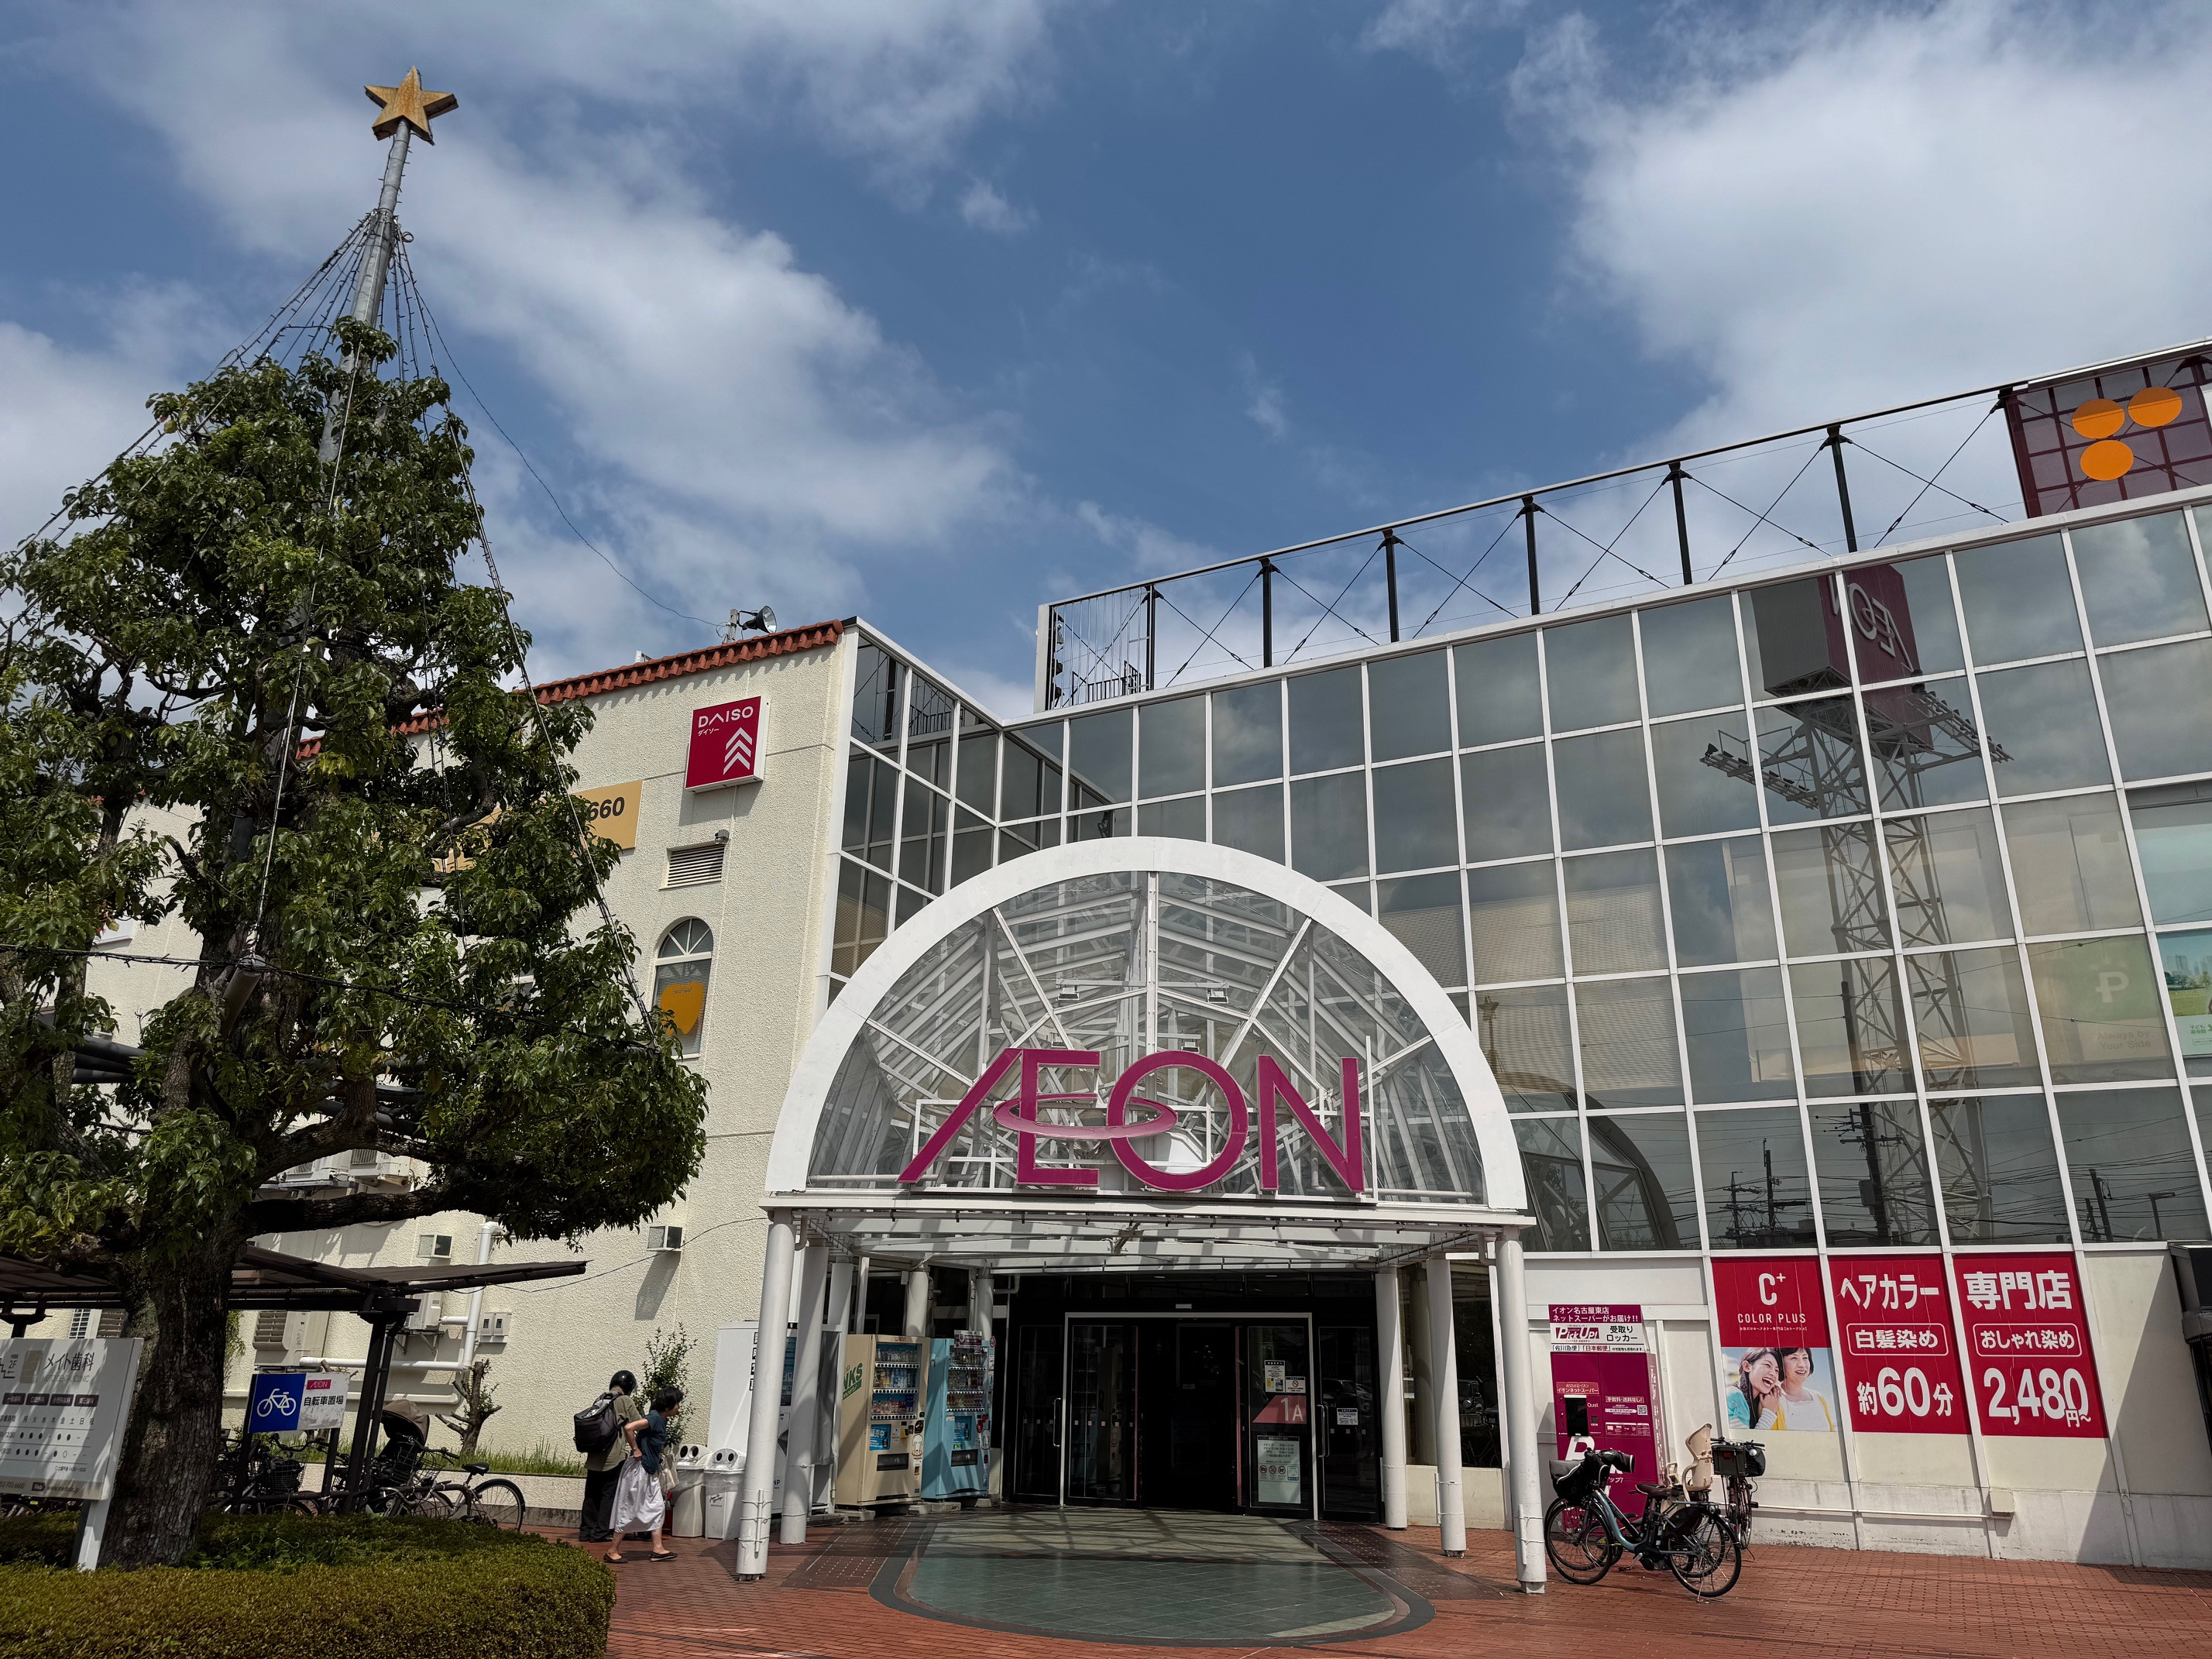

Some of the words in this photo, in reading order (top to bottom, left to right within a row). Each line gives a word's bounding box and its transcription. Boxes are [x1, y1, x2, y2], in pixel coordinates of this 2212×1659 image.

[698, 706, 754, 728] DAISO
[698, 728, 720, 737] ダイソー
[897, 1048, 1365, 1193] AEON
[1840, 1273, 1939, 1310] ヘアカラー
[1963, 1269, 2073, 1310] 専門店
[1737, 1313, 1772, 1323] COLOR
[1778, 1313, 1806, 1323] PLUS
[1854, 1329, 1939, 1350] 白髪染め
[1980, 1329, 2076, 1350] おしゃれ染め
[9, 1360, 17, 1369] 2F
[44, 1352, 94, 1371] メイト歯科
[304, 1395, 344, 1407] 自転車置場
[1856, 1366, 1954, 1417] 約60分
